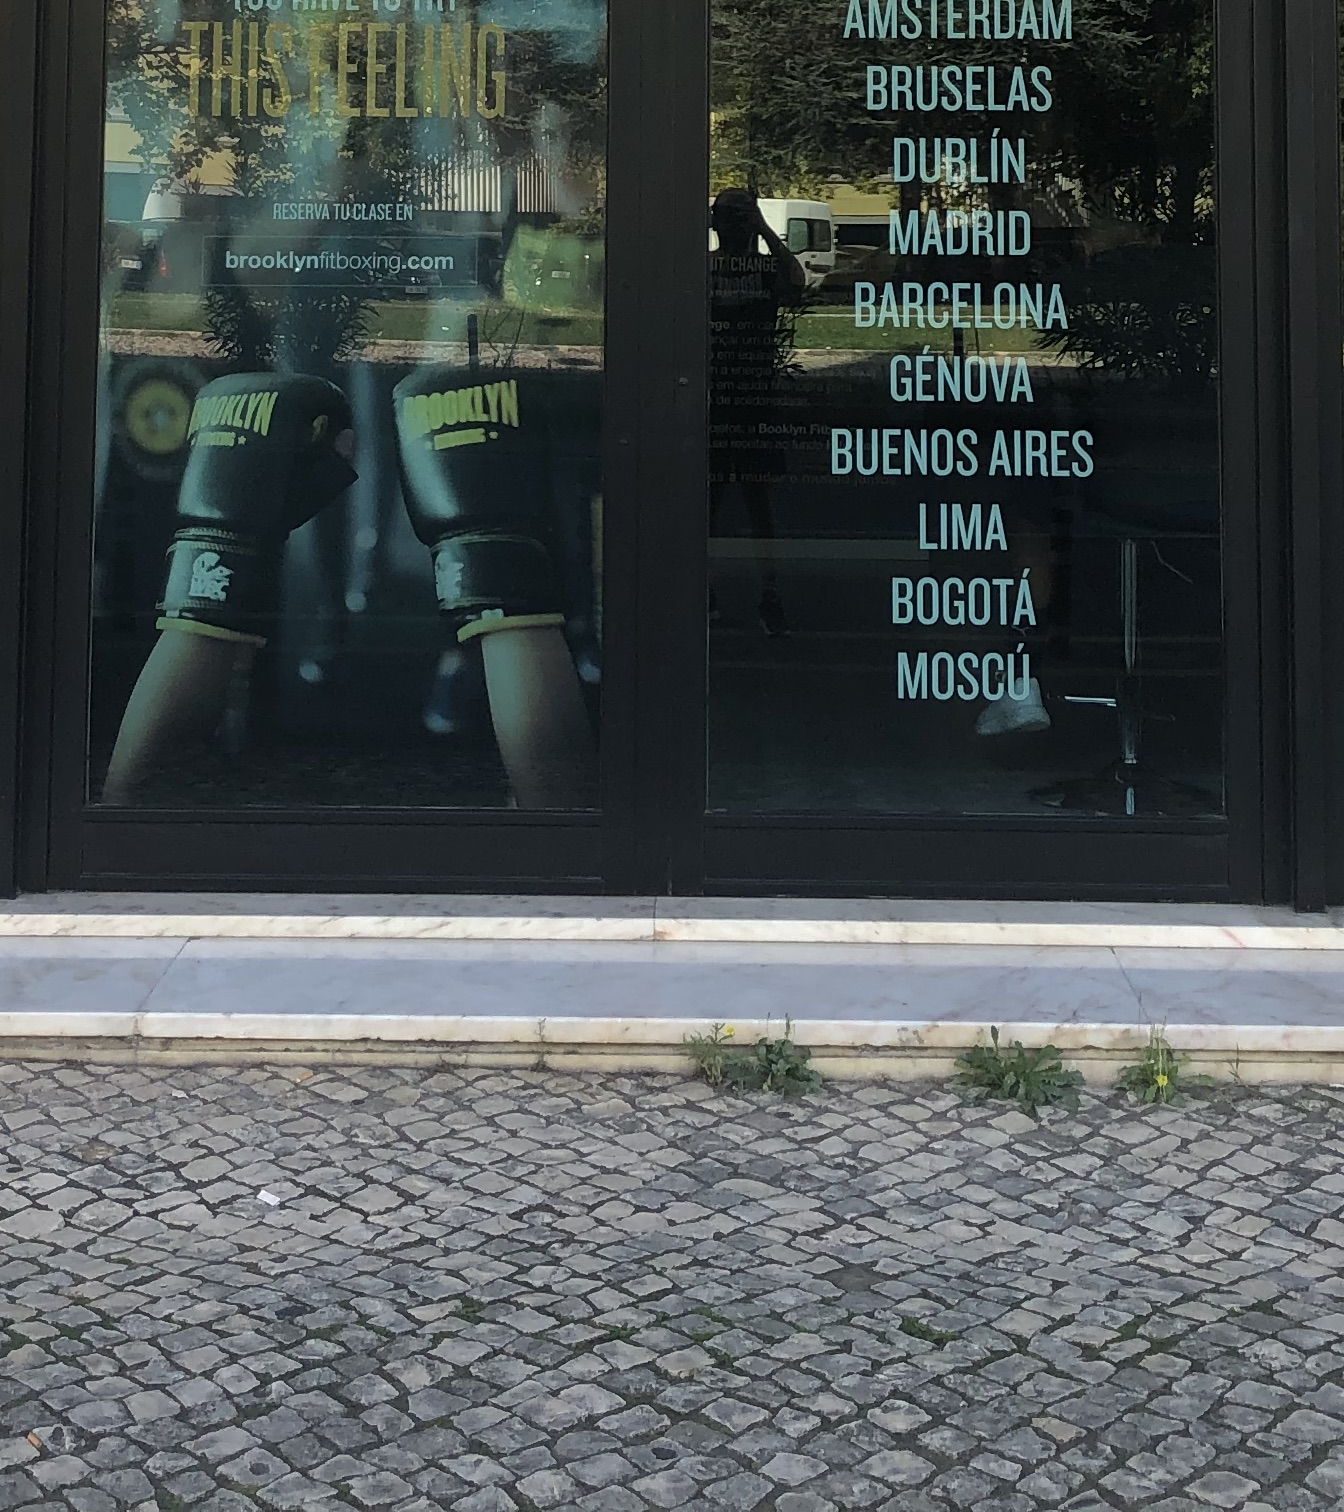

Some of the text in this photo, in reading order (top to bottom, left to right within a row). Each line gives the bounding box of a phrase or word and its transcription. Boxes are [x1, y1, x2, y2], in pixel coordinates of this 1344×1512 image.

[181, 21, 506, 119] THIS FEELING
[866, 65, 1053, 112] BRUSELAS
[893, 128, 1025, 183] DUBLÍN
[272, 203, 414, 221] RESERVA TU CLASE EN
[889, 210, 1031, 256] MADRID
[225, 250, 454, 275] brooklynfitboxing.com
[854, 282, 1069, 329] BARCELONA
[889, 345, 1034, 402] GÉNOVA
[831, 428, 1095, 478] BUENOS AIRES
[919, 503, 1008, 550] LIMA
[891, 568, 1037, 626] BOGOTÁ
[896, 643, 1031, 701] MOSCÚ
